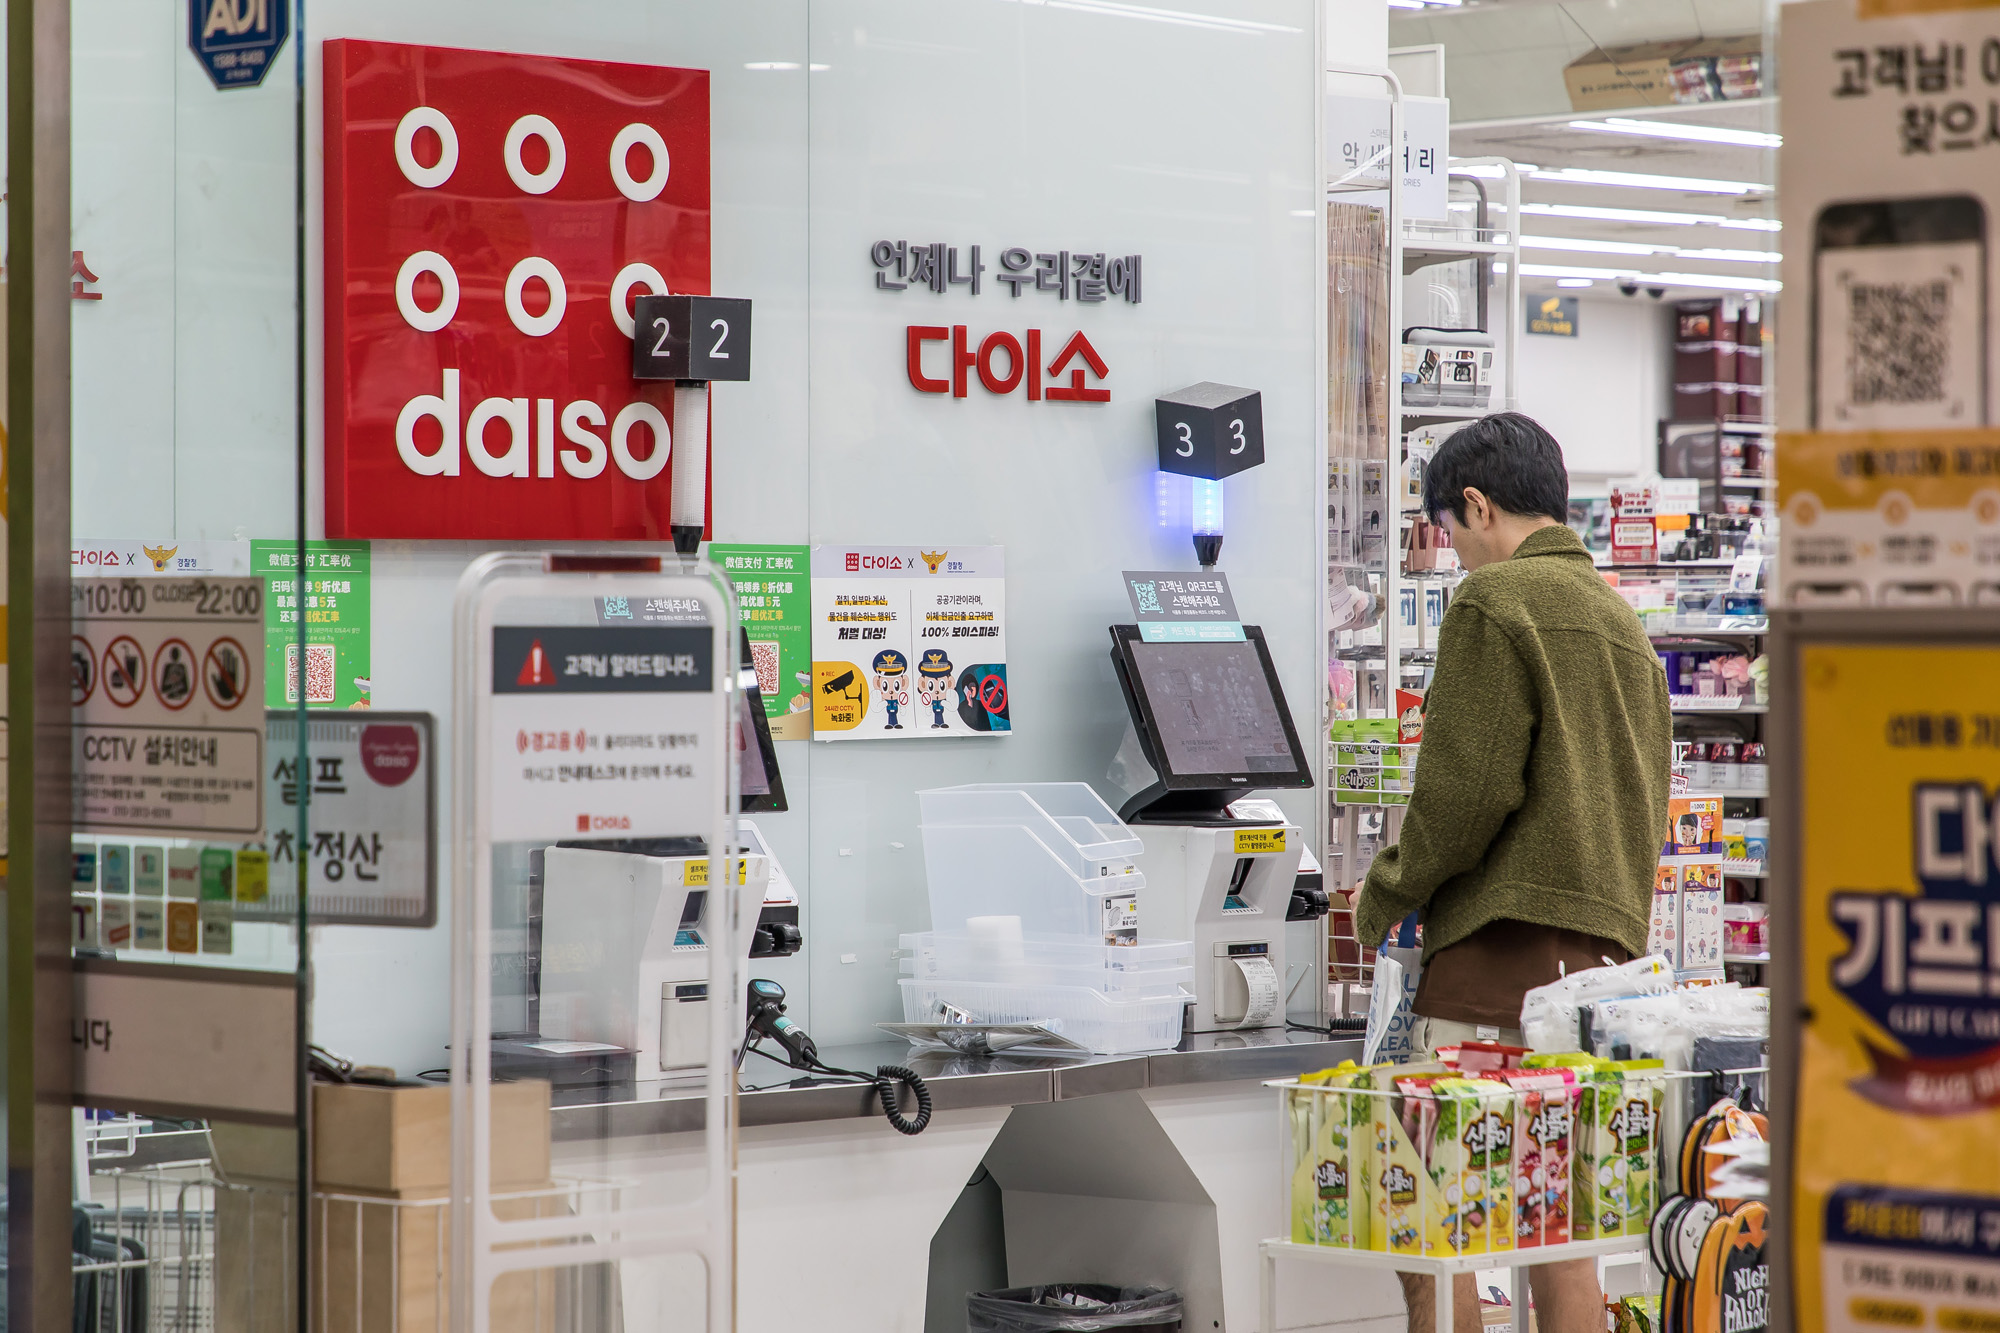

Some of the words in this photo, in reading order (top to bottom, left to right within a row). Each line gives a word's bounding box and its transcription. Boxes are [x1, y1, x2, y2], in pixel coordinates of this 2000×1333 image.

[871, 239, 985, 296] 언제나
[997, 246, 1143, 304] 우리곁에
[651, 317, 671, 357] 2
[708, 318, 730, 359] 2
[906, 324, 1112, 403] 다이소
[395, 368, 672, 481] daiso
[1174, 422, 1195, 458] 3
[1228, 418, 1247, 456] 3
[725, 557, 762, 569] 微信支付
[765, 557, 794, 569] 汇率优
[862, 556, 902, 569] 다이소
[733, 582, 760, 593] 码领券
[1159, 580, 1187, 593] 고객님,
[1187, 580, 1224, 593] QR코드를
[737, 596, 765, 607] 高优惠
[936, 594, 983, 606] 공공기관이라며,
[1172, 595, 1220, 608] 스캔해주세요
[838, 626, 859, 640] 처벌
[861, 626, 887, 640] 대상!
[921, 626, 950, 638] 100%
[951, 626, 1000, 638] 보이스피싱!
[831, 713, 854, 723] 녹화중!
[82, 736, 137, 762] CCTV
[1339, 773, 1376, 789] eclipse
